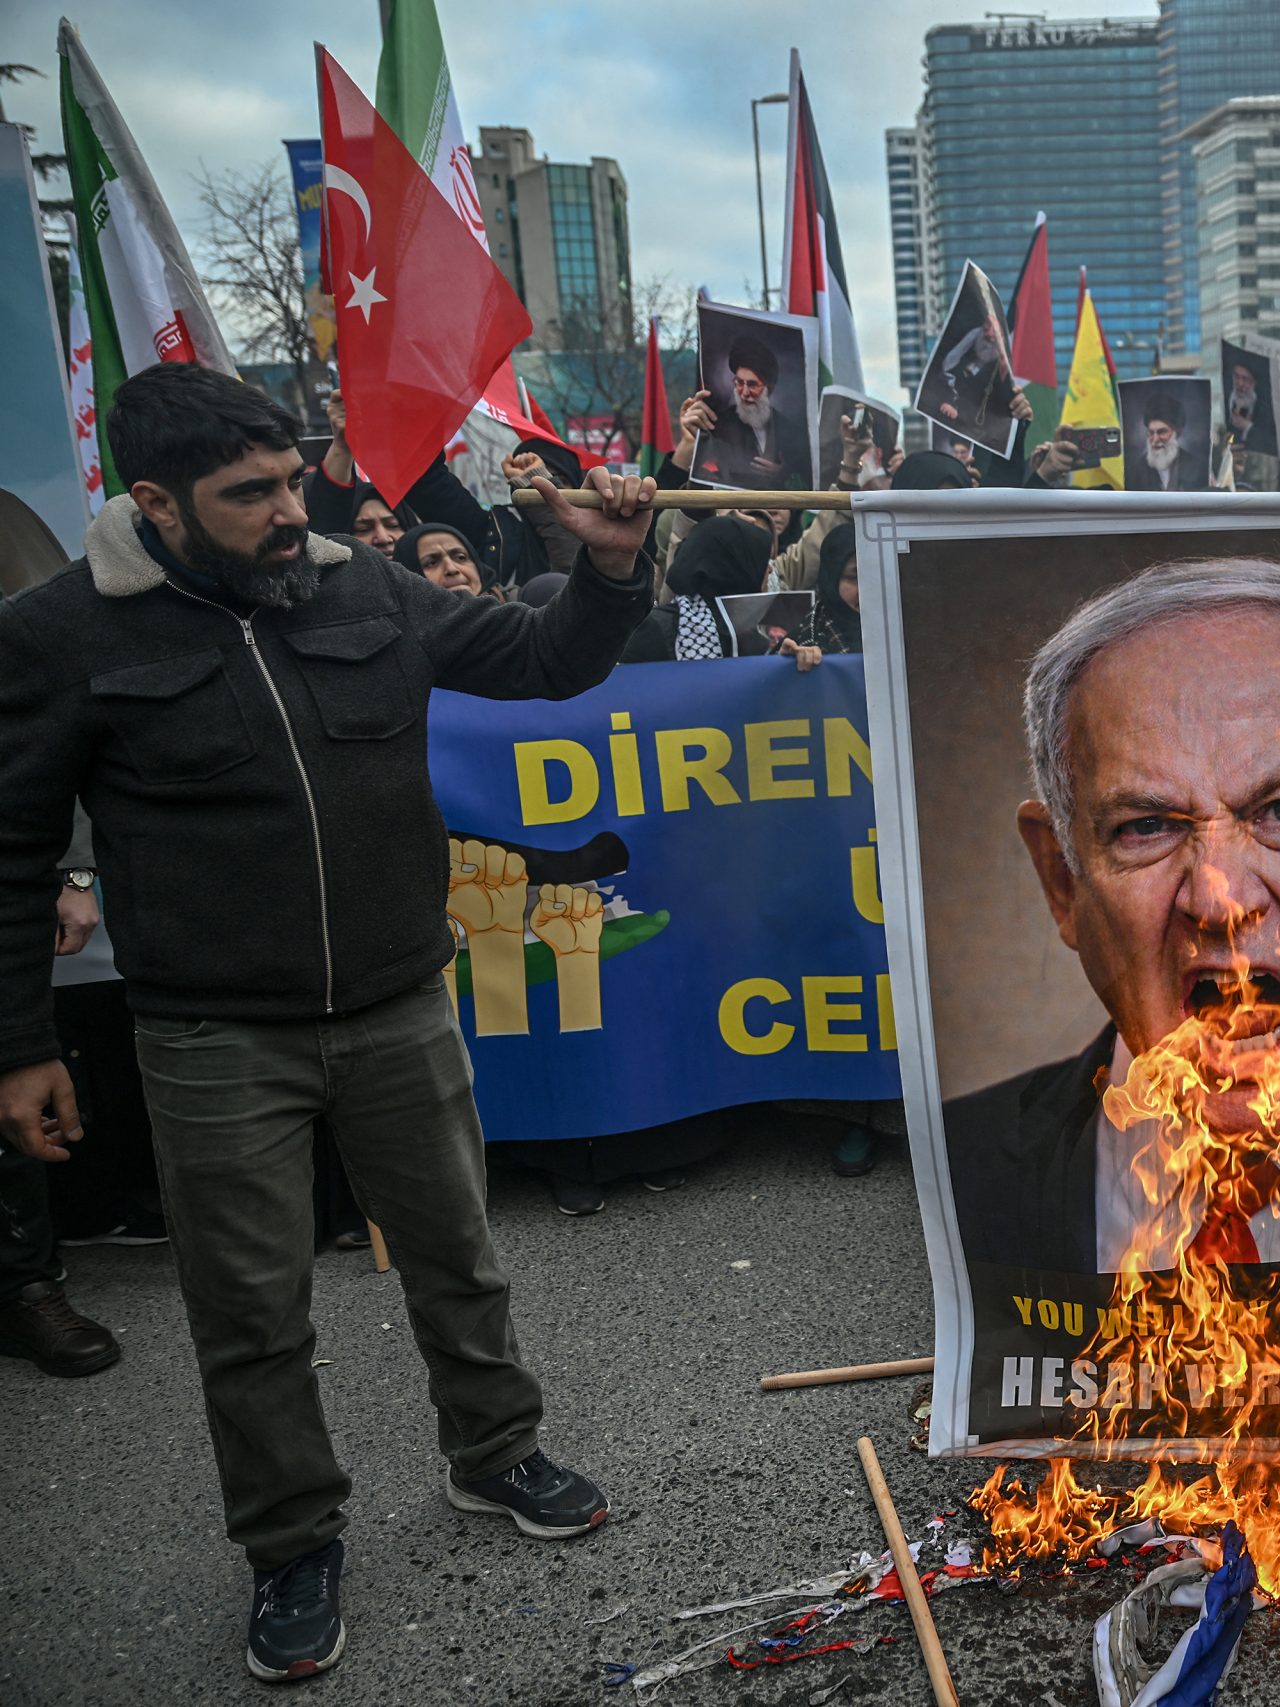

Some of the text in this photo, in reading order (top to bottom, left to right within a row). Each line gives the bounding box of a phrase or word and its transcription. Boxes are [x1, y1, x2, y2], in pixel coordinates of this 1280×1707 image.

[1012, 1295, 1084, 1337] YOU
[1096, 1304, 1189, 1340] WILL
[1001, 1356, 1166, 1409] HESAP
